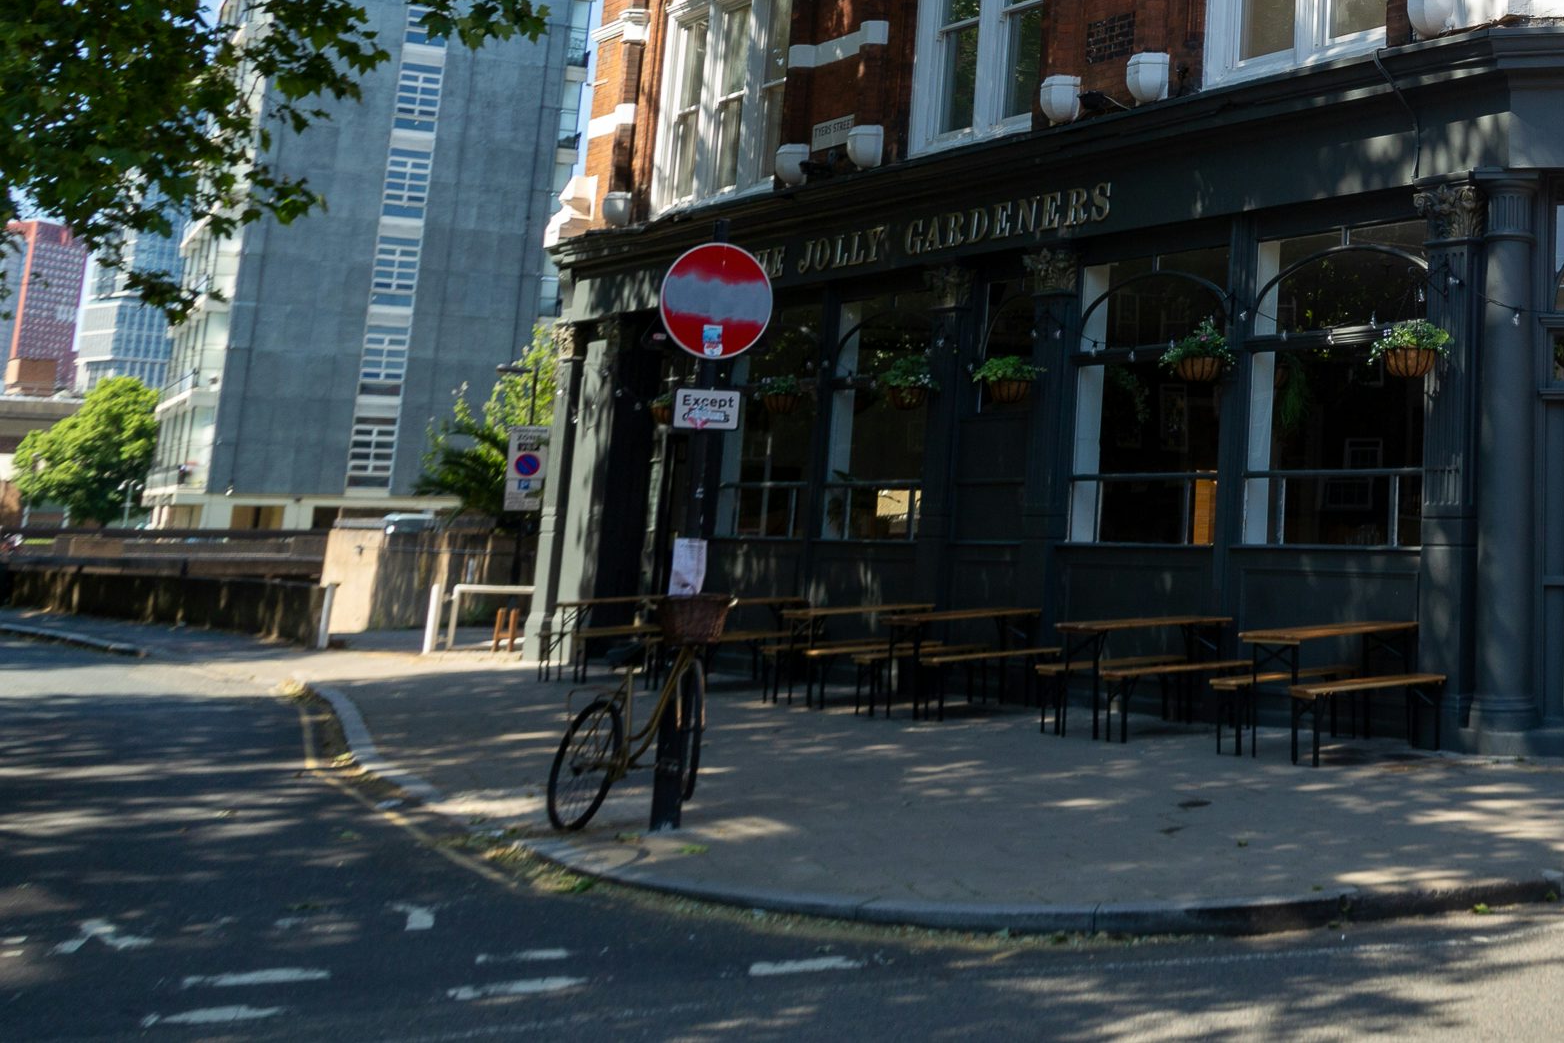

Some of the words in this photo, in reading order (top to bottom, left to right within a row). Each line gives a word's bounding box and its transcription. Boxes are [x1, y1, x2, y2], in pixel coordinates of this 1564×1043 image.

[753, 245, 786, 280] HE
[797, 224, 888, 274] JOLLY
[904, 181, 1112, 256] GARDENERS
[682, 394, 735, 410] Except
